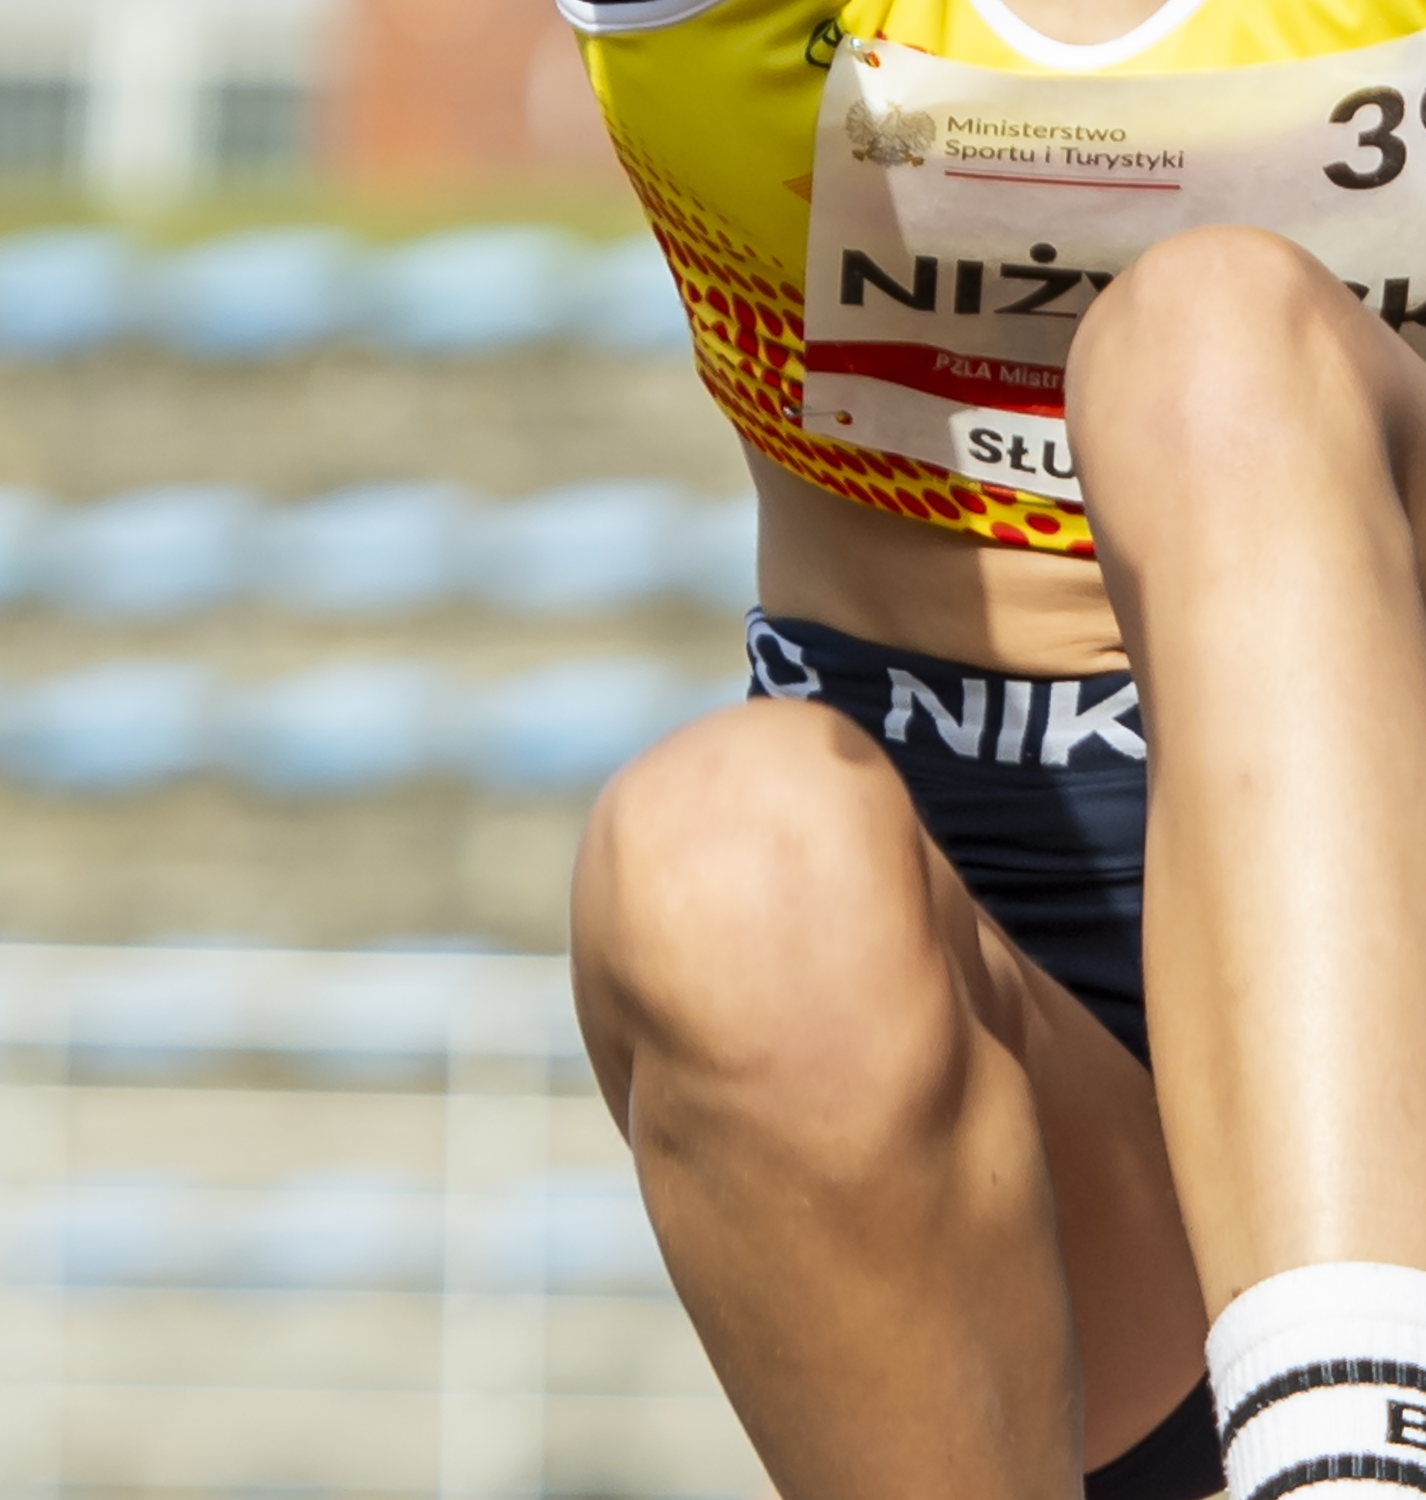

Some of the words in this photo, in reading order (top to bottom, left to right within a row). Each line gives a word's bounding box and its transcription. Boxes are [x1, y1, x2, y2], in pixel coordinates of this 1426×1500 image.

[946, 115, 1127, 143] Ministerstwo
[944, 138, 1035, 163] Sportu
[1044, 145, 1051, 164] i
[1059, 146, 1185, 171] Turystyki
[931, 352, 993, 382] PZLA
[1000, 365, 1065, 390] Mistr
[967, 427, 1077, 480] SŁU
[883, 666, 1148, 767] NIK
